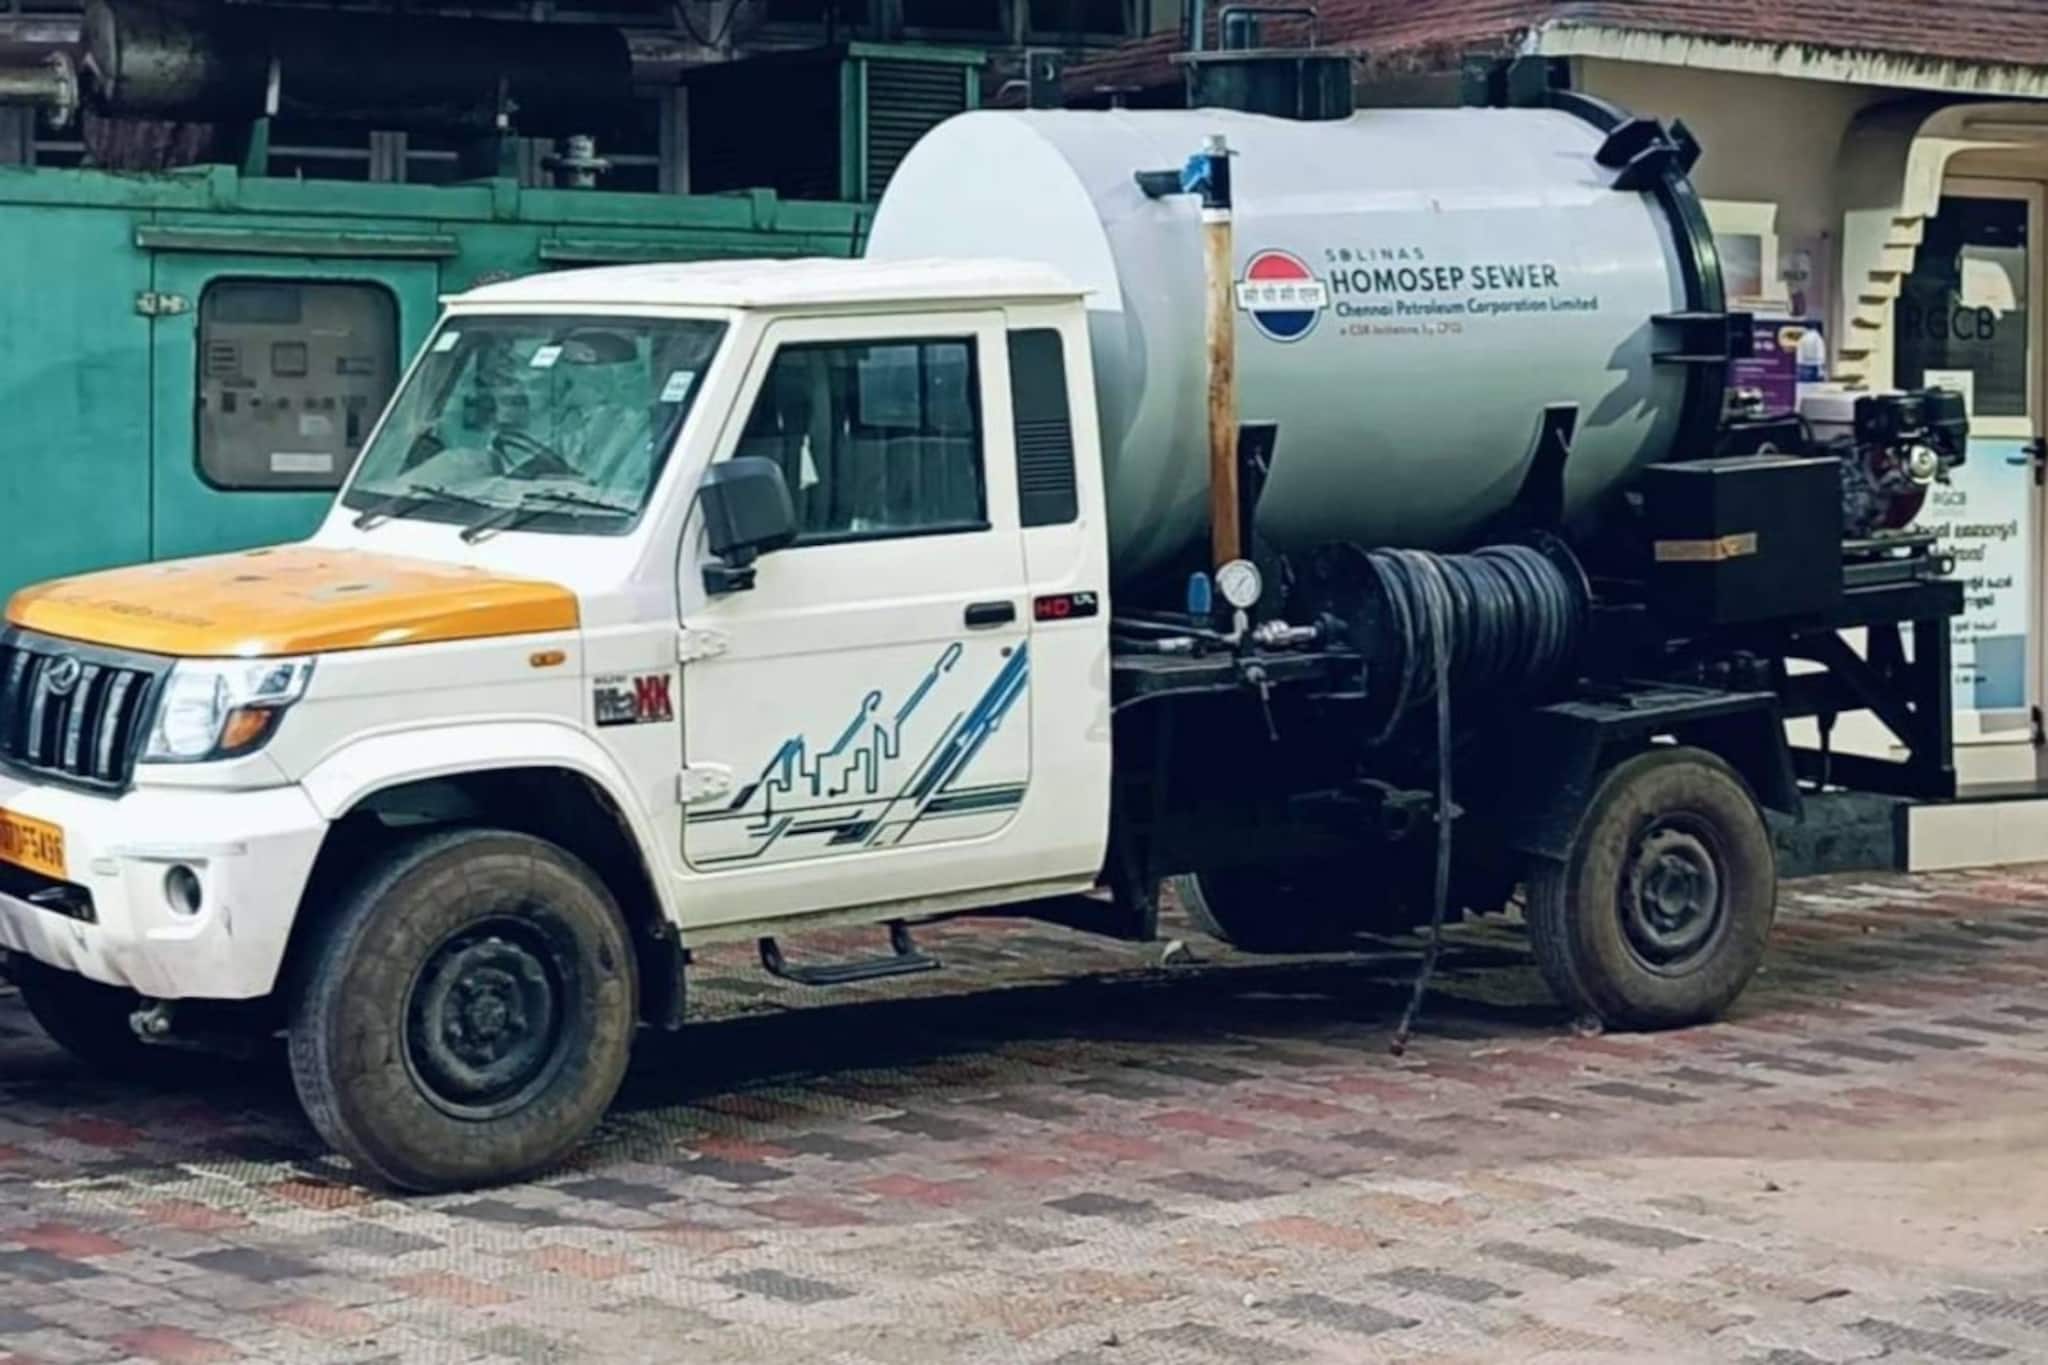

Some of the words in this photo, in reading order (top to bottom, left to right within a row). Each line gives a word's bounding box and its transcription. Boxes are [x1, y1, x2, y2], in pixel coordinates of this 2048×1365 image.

[1330, 266, 1464, 295] HOMOSEP
[1471, 264, 1560, 290] SEWER
[1336, 301, 1393, 317] Chennai
[1396, 299, 1466, 316] Petroleum
[1467, 297, 1548, 317] Corporation
[1551, 296, 1598, 311] Limited
[1904, 305, 1995, 340] RGCB
[1035, 598, 1071, 617] HD
